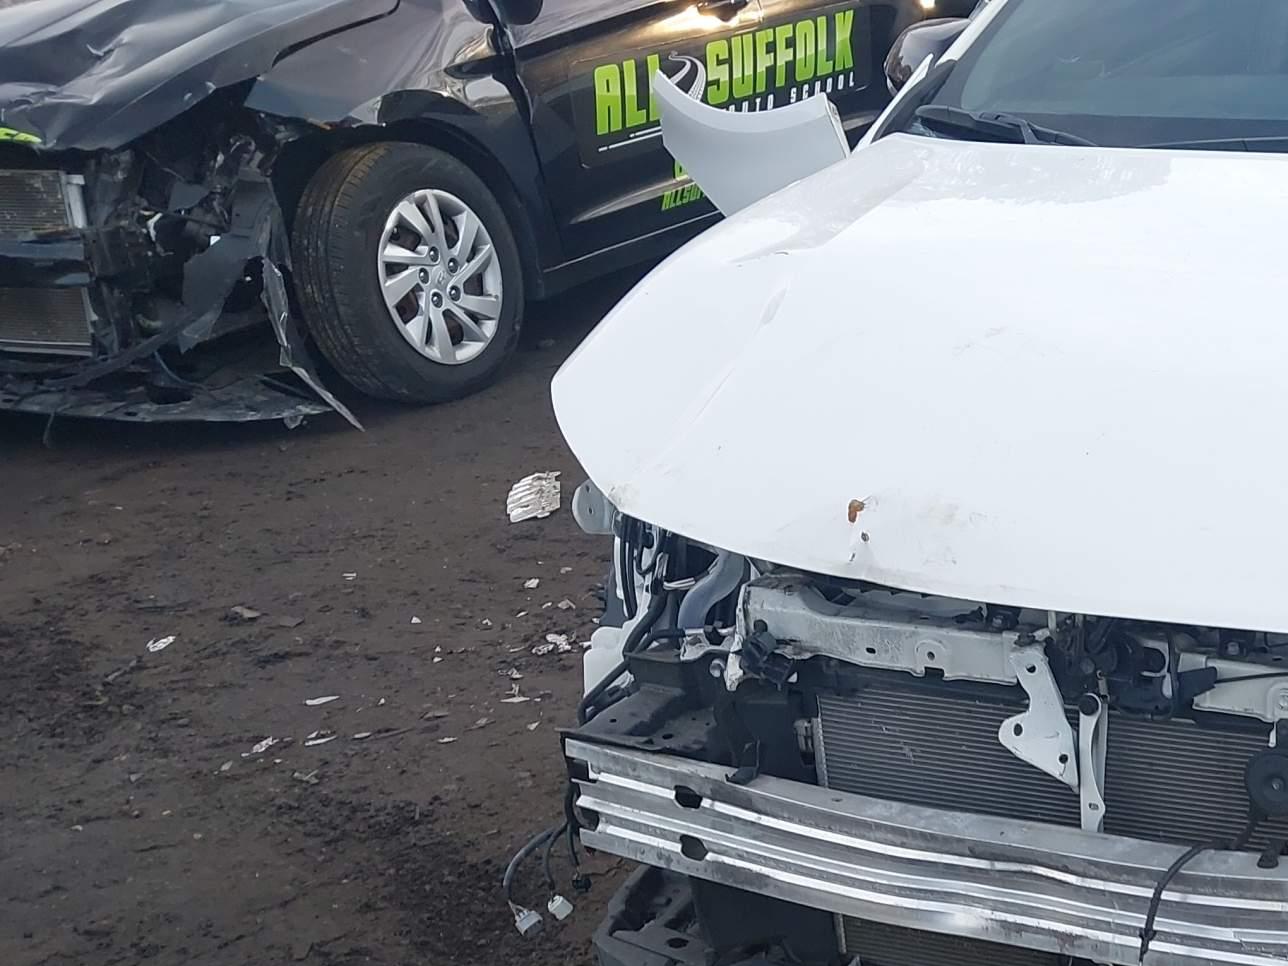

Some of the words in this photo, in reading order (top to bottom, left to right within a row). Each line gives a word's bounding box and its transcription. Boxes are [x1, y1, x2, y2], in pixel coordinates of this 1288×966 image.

[594, 54, 663, 136] ALL
[706, 9, 854, 105] SUFFOLK
[790, 71, 855, 104] SCHOOL
